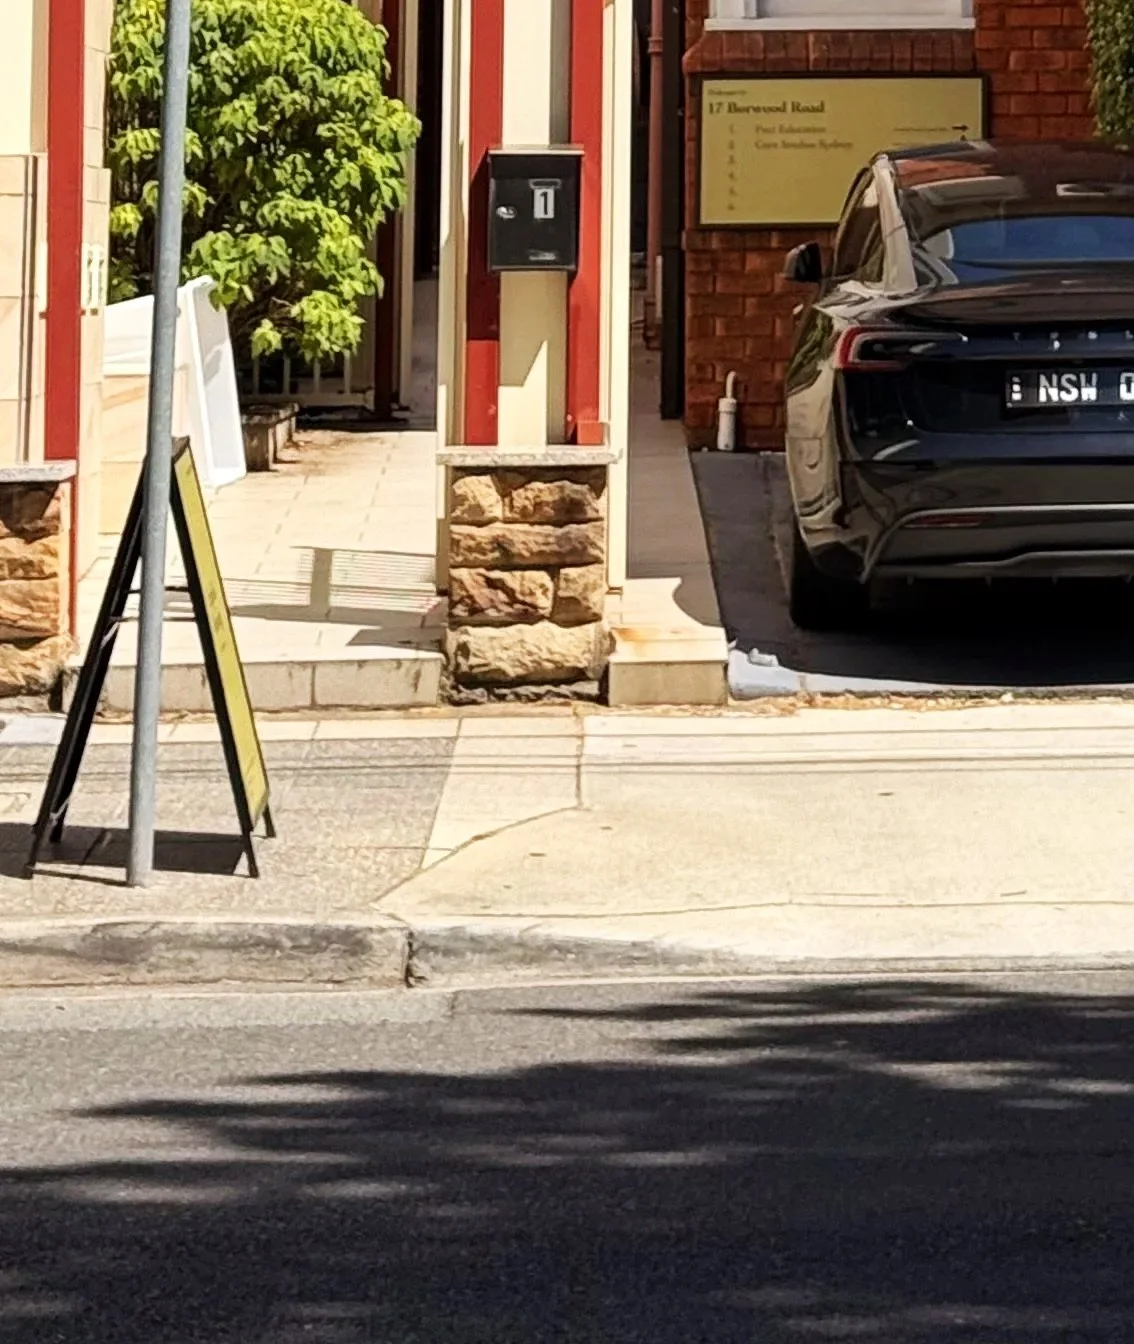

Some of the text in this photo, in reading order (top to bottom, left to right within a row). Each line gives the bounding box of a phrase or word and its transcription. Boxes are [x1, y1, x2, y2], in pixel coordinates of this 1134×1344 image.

[708, 102, 722, 114] 17
[791, 100, 825, 113] Road
[540, 192, 548, 215] 1
[1039, 372, 1097, 402] NSW
